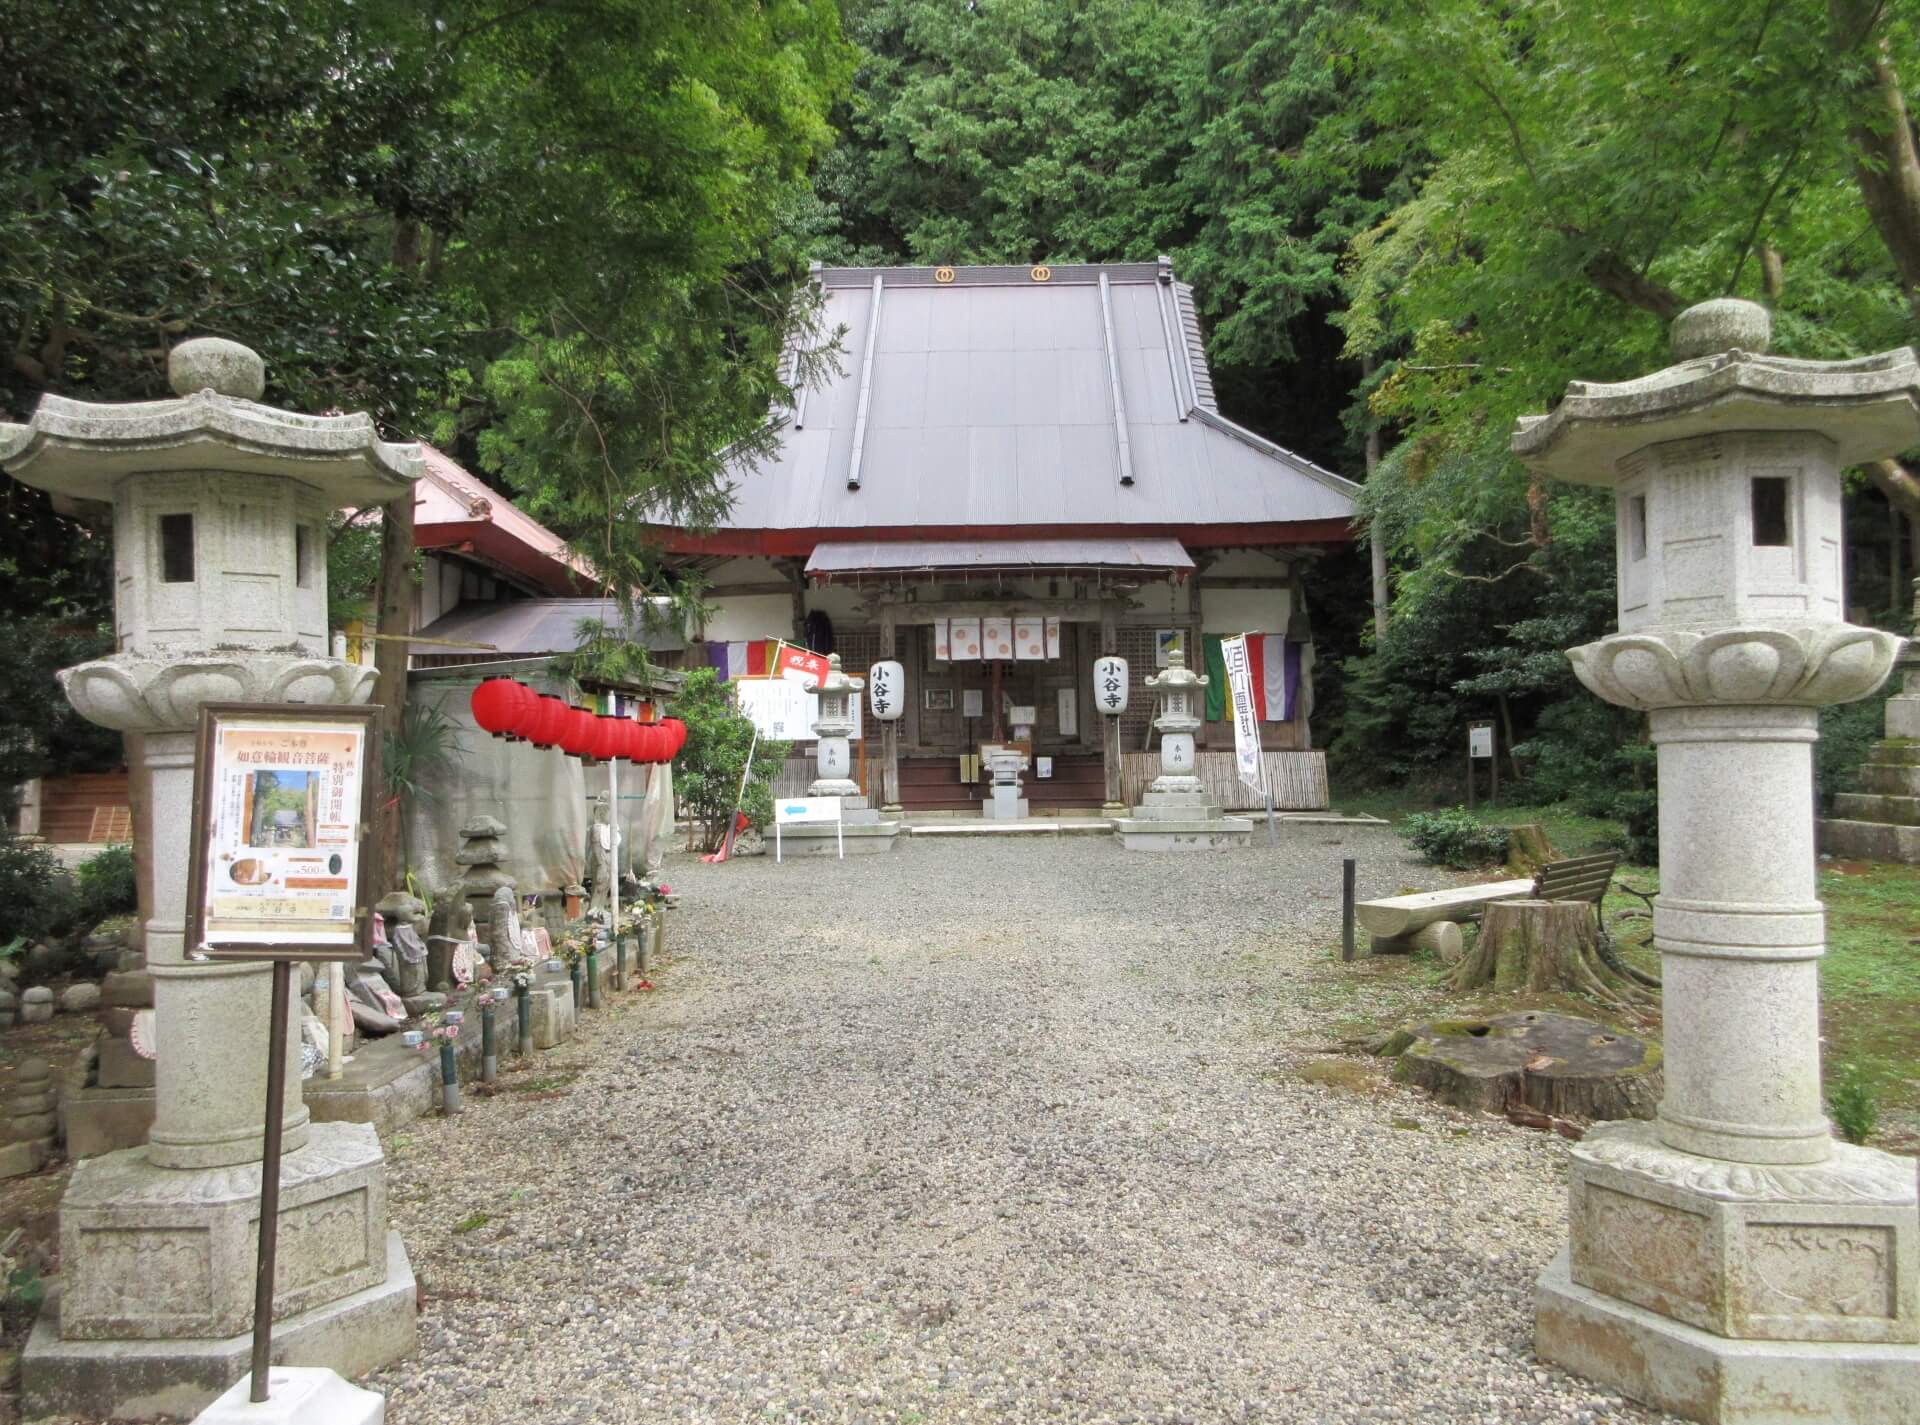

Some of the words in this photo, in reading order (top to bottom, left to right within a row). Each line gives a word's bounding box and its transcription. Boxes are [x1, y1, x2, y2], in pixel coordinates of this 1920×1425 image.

[872, 665, 891, 714] 小谷寺
[1102, 661, 1122, 709] 小谷寺
